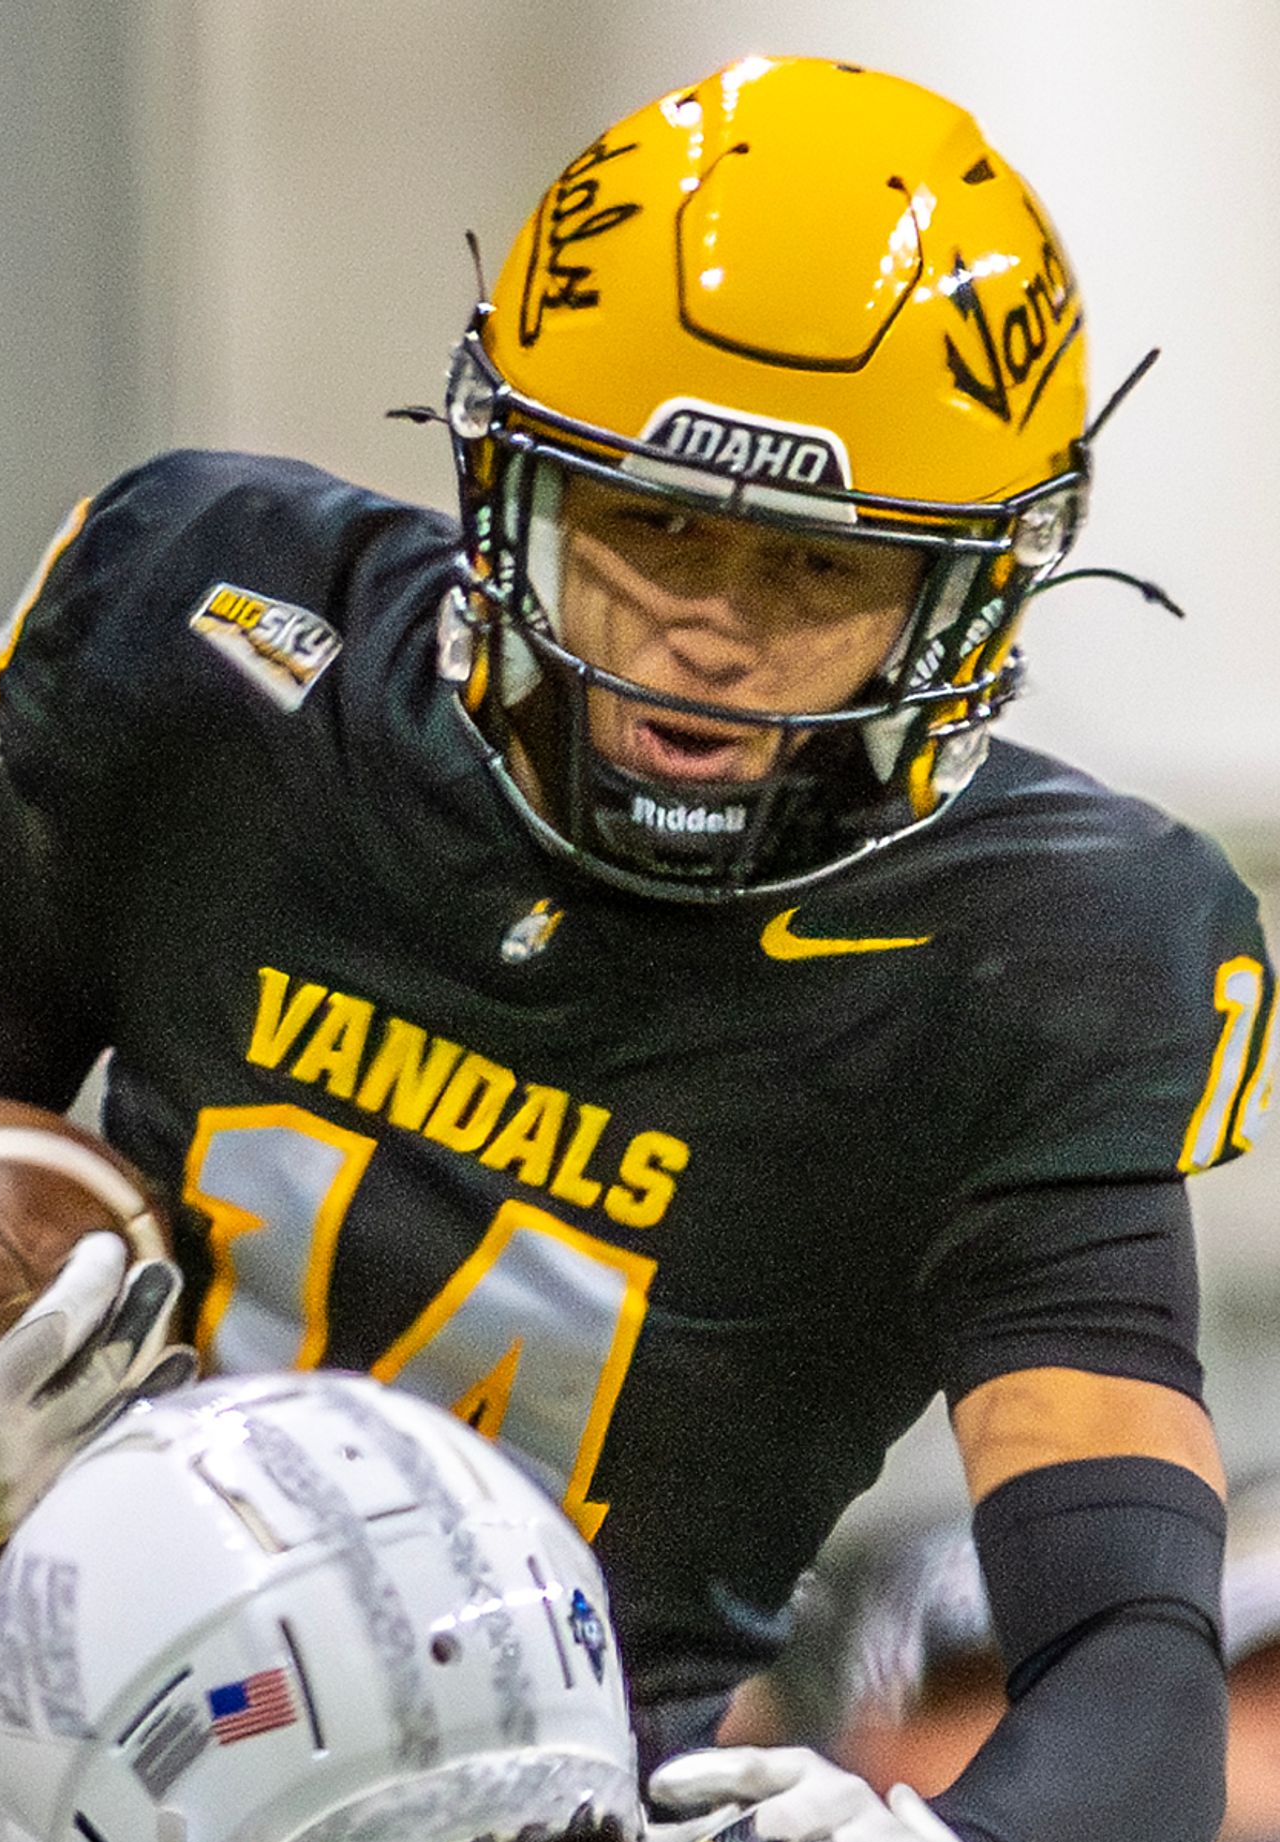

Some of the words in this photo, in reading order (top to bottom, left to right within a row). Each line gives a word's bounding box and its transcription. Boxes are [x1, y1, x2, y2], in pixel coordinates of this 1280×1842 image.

[666, 414, 829, 485] IDAHO
[631, 795, 748, 833] Riddell
[245, 965, 691, 1228] VANDALS
[183, 1103, 659, 1543] 14
